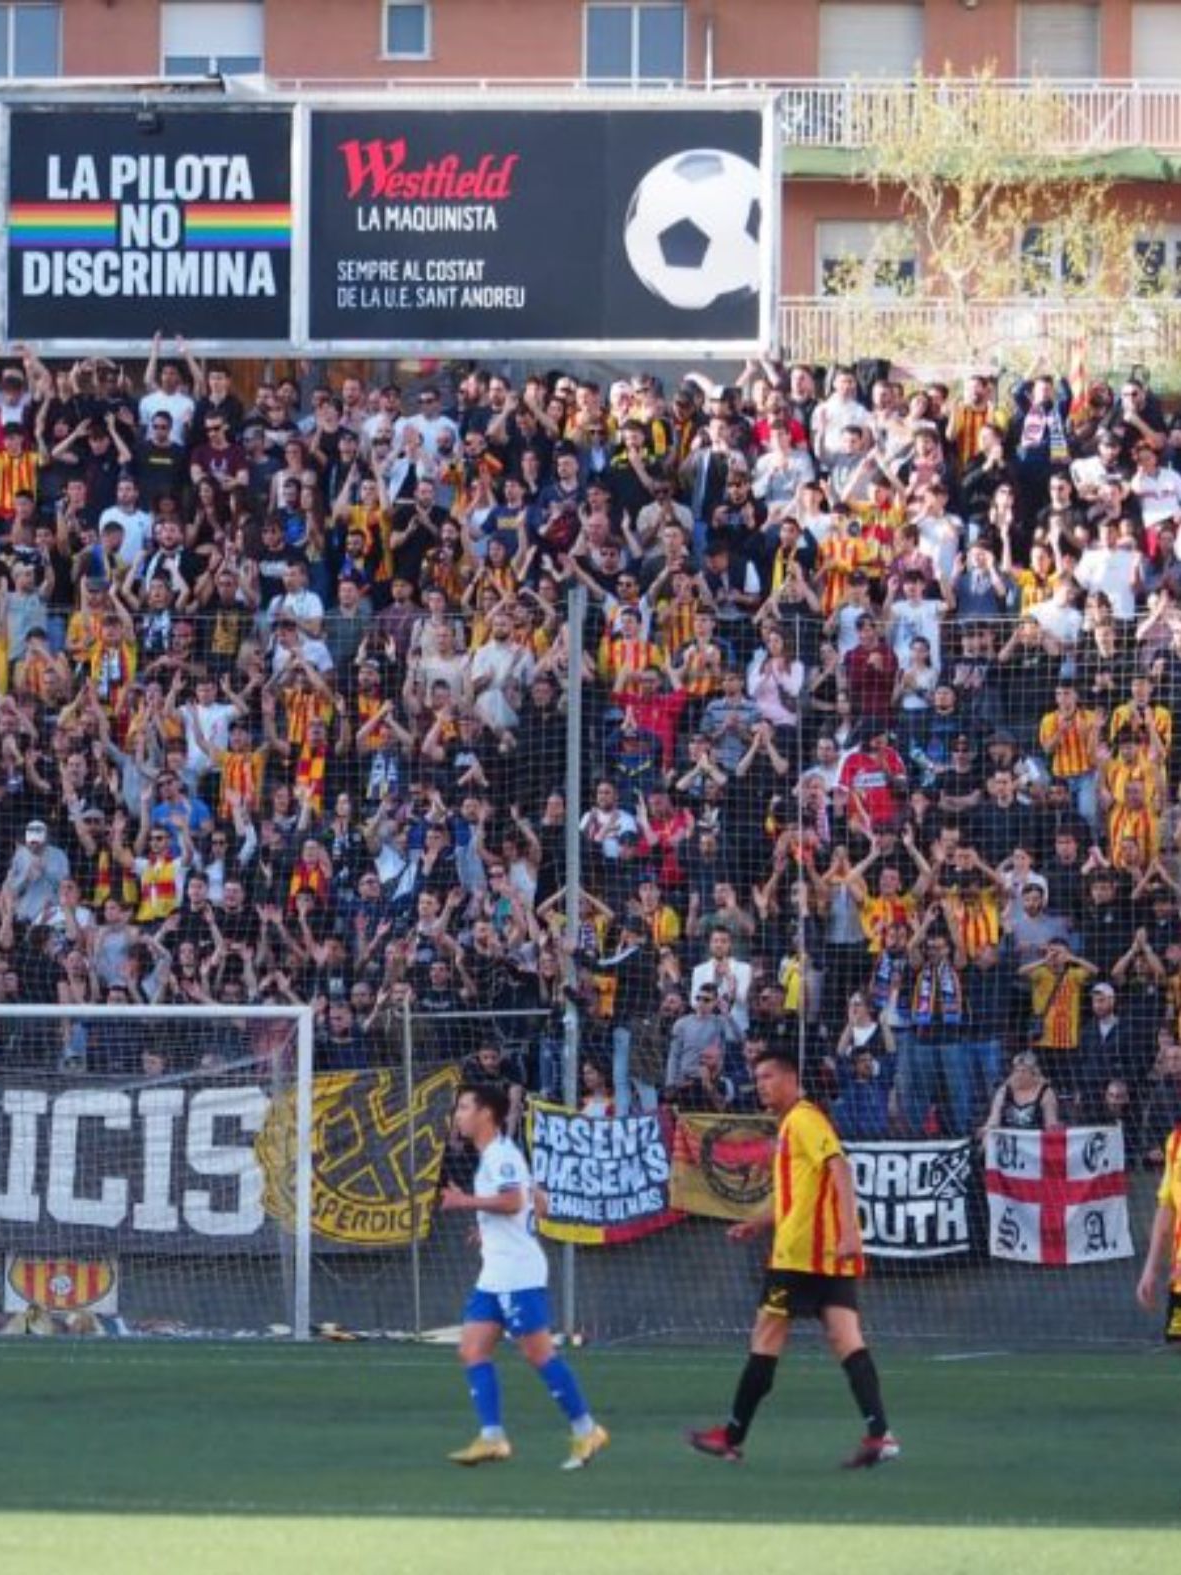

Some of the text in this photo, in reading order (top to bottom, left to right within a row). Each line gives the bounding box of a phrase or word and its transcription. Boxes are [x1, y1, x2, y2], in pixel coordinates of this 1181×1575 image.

[46, 154, 255, 201] LA PILOTA
[338, 137, 520, 200] Westfield
[120, 201, 181, 249] NO
[357, 205, 499, 233] LA MAQUINISTA
[21, 250, 277, 297] DISCRIMINA
[337, 259, 486, 282] SEMPRE AL COSTAT
[337, 285, 526, 309] DE LA U.E. SANT ANDREU
[857, 1196, 969, 1244] OUTH
